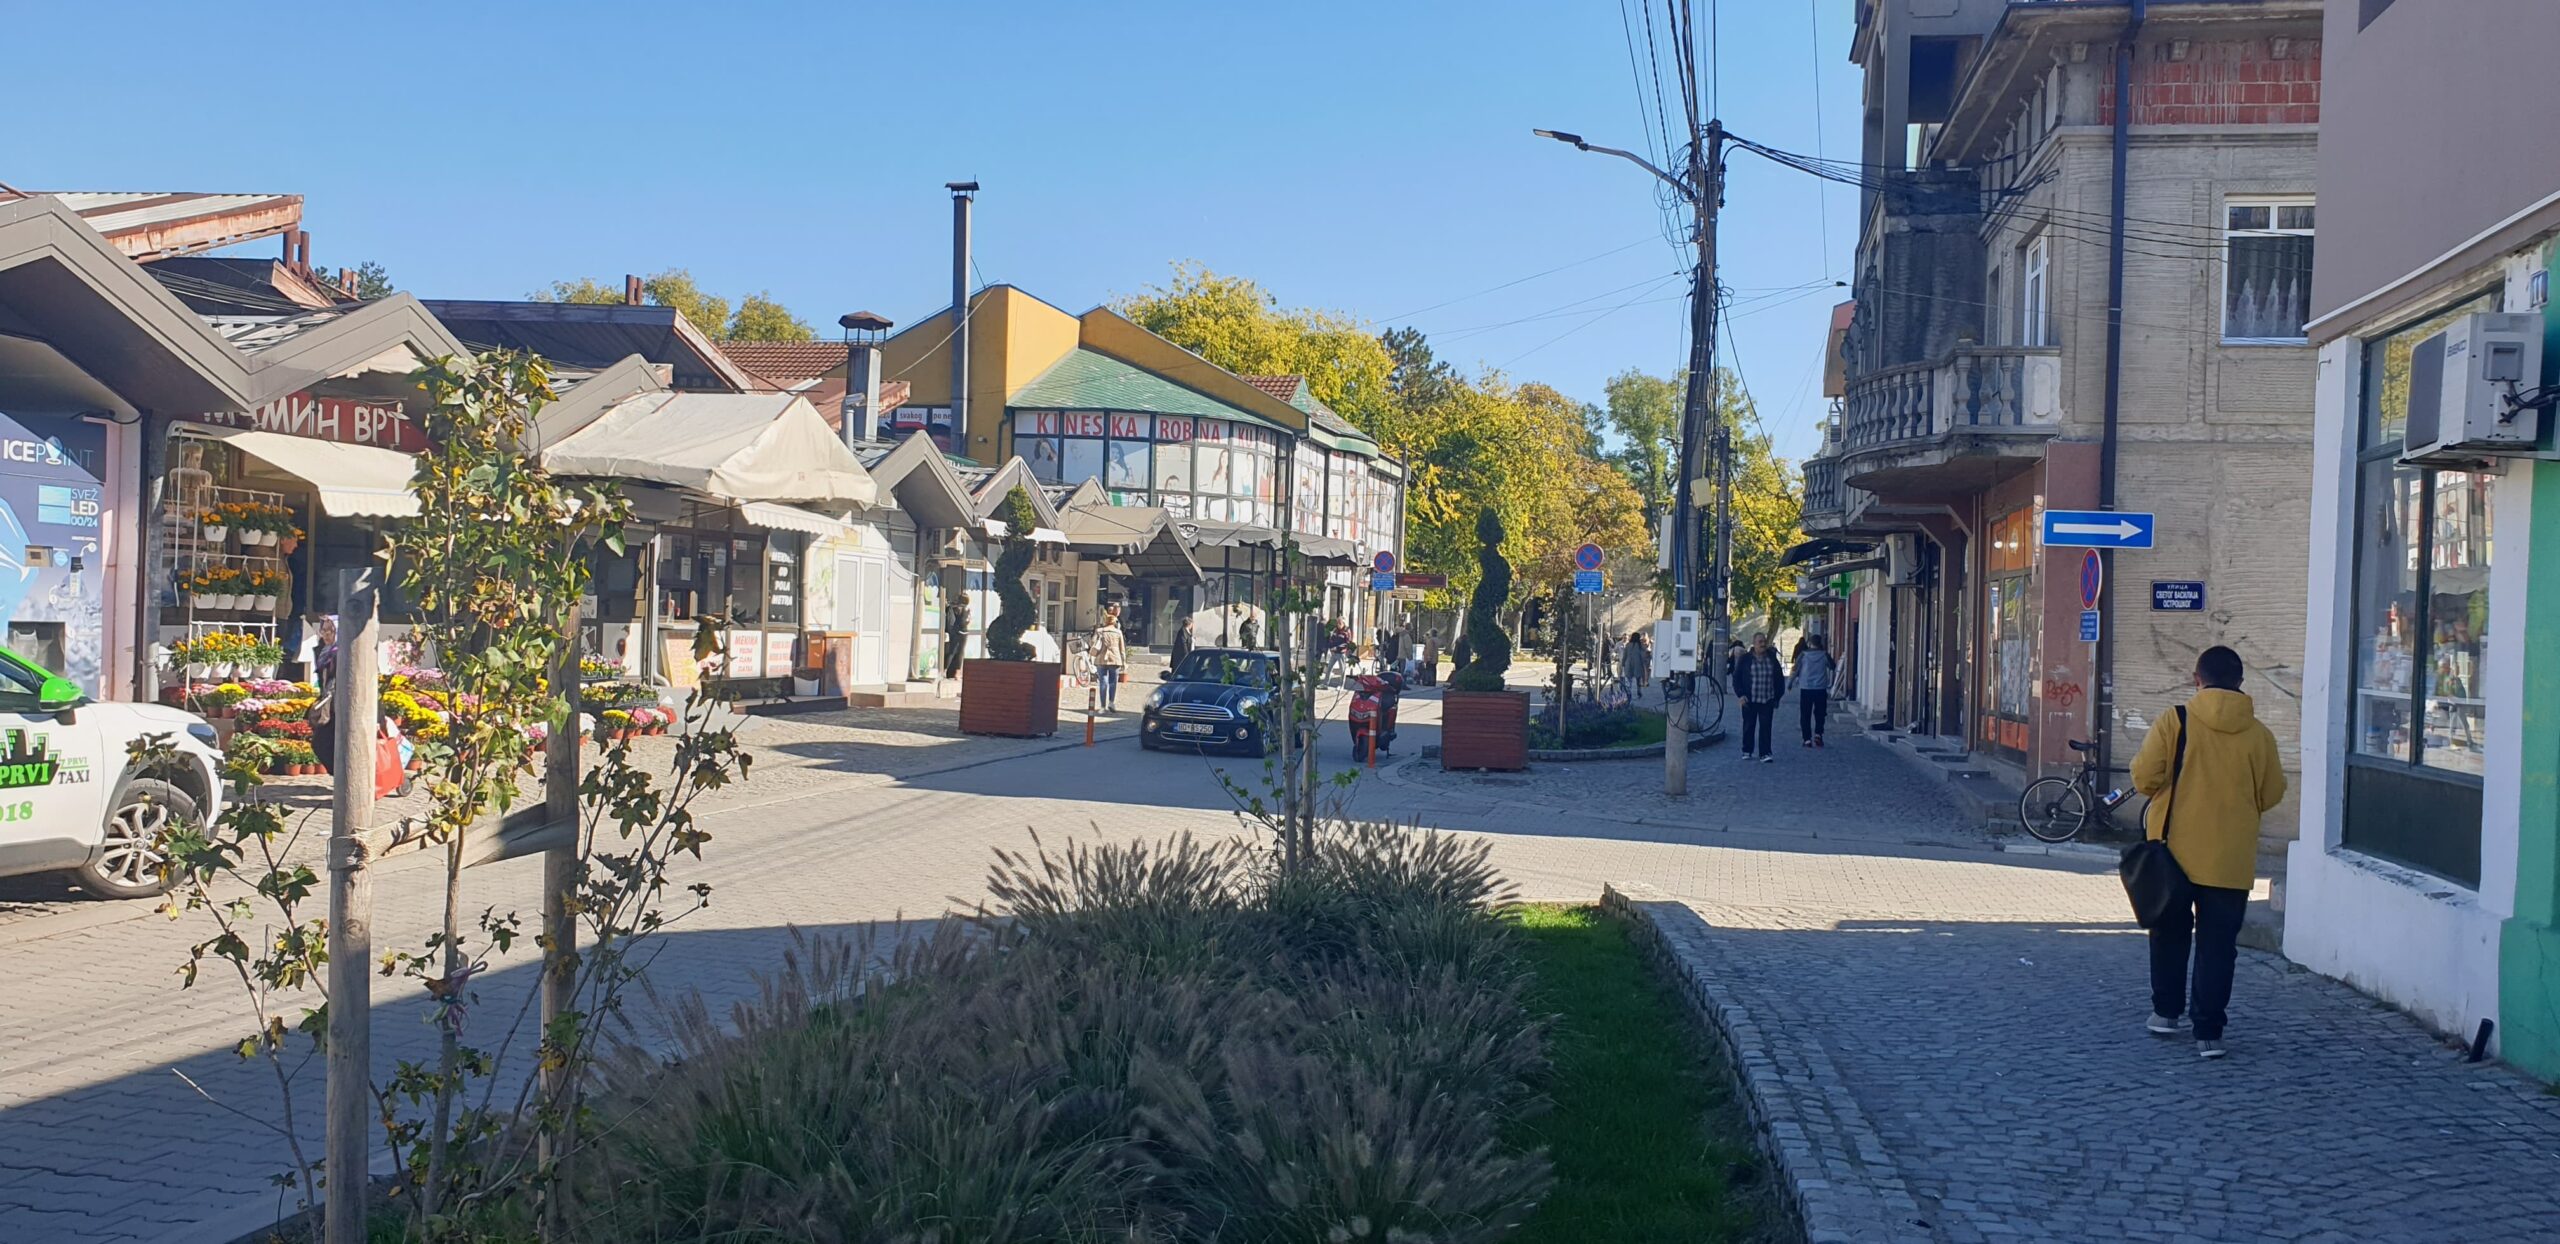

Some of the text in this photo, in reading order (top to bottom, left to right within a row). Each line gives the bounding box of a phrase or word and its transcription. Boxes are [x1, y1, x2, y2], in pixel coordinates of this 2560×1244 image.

[1036, 412, 1138, 438] KINESKA
[1159, 418, 1222, 444] ROBNA
[71, 488, 98, 501] SVEŽ
[71, 500, 99, 516] LED
[2155, 591, 2199, 599] СВЕТОГ ВАСИЛИЈА
[0, 763, 50, 786] PRVI
[58, 769, 90, 784] TAXI
